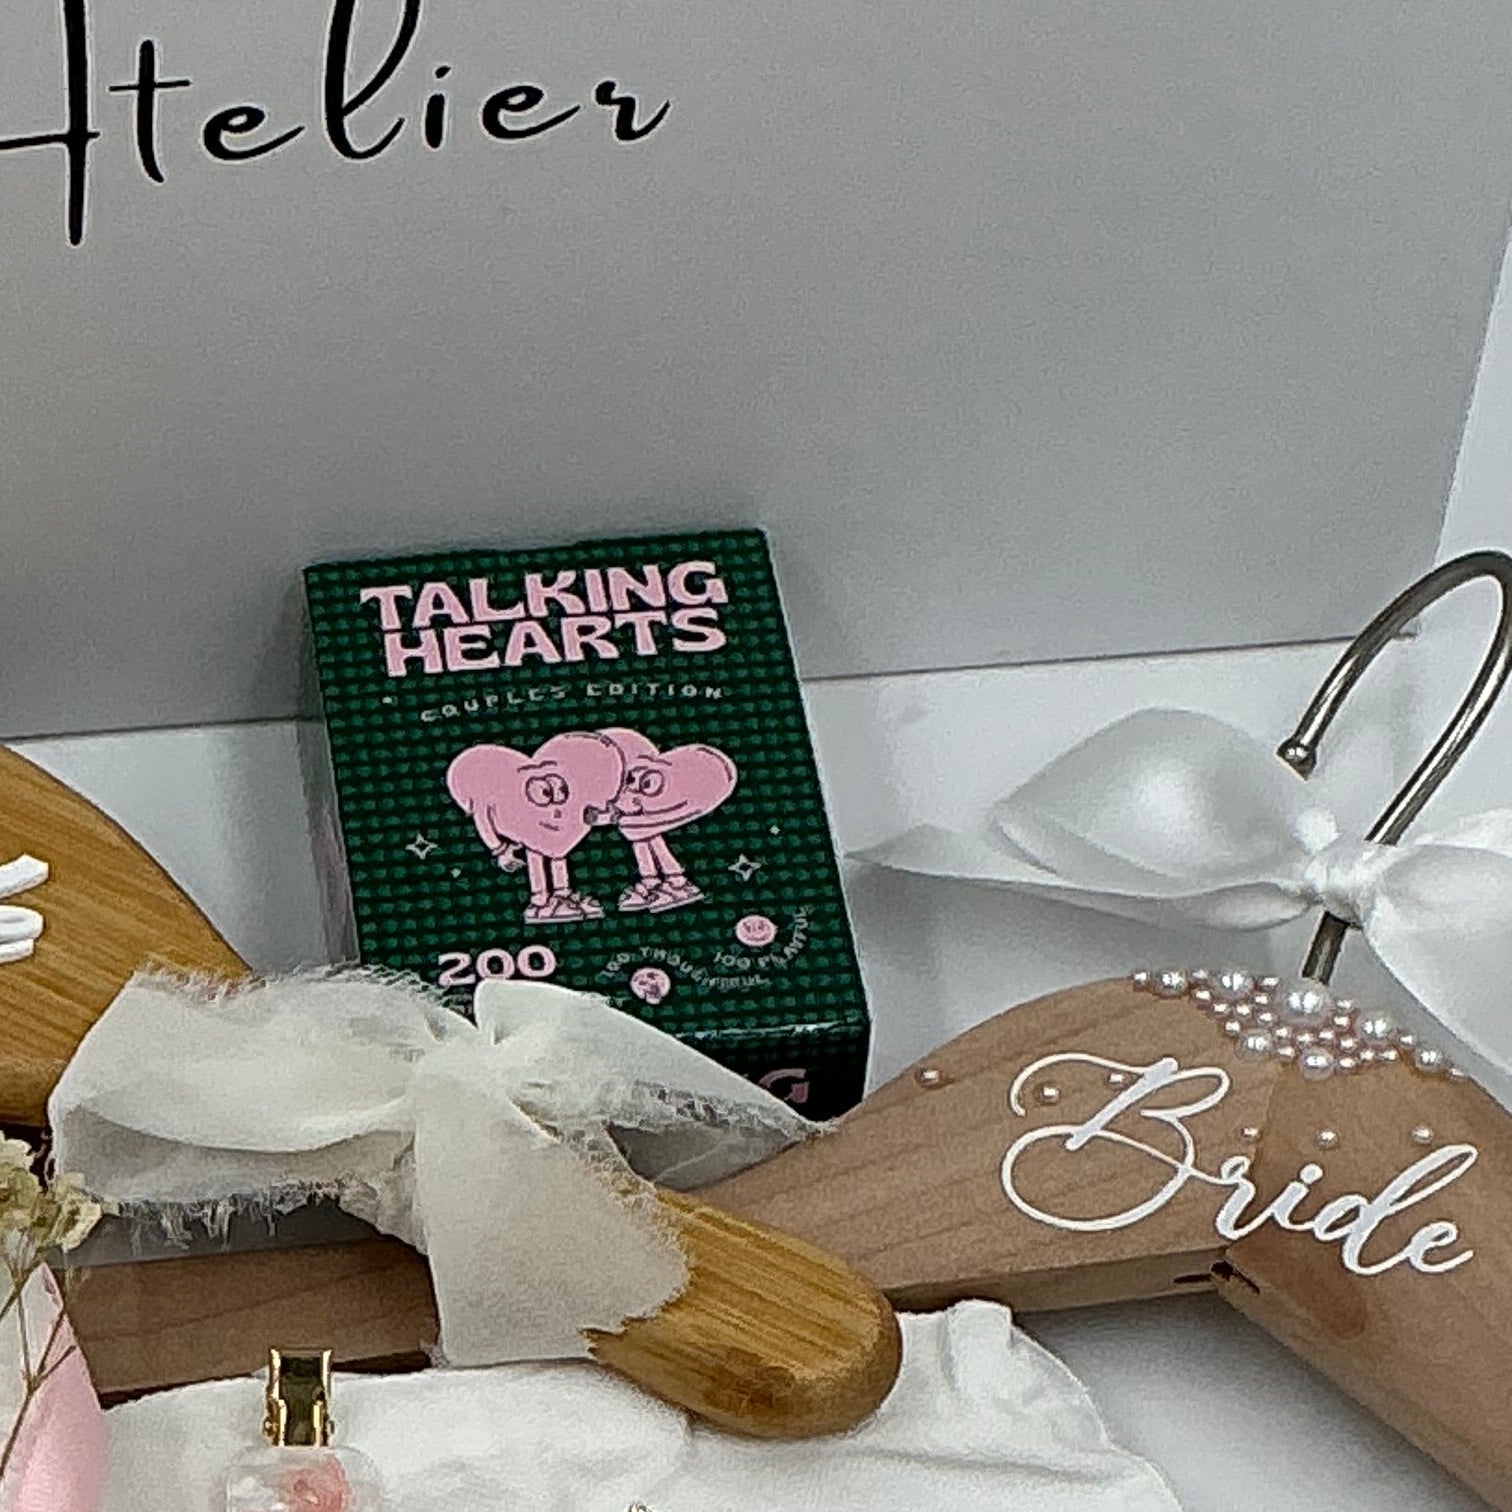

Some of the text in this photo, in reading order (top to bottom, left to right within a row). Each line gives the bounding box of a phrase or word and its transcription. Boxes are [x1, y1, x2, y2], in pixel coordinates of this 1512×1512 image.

[360, 560, 729, 631] TALKING
[384, 607, 728, 678] HEARTS
[420, 682, 724, 722] COUPLES EDITION
[437, 944, 557, 986] 200
[713, 952, 752, 971] 100
[1000, 1053, 1479, 1276] Bride
